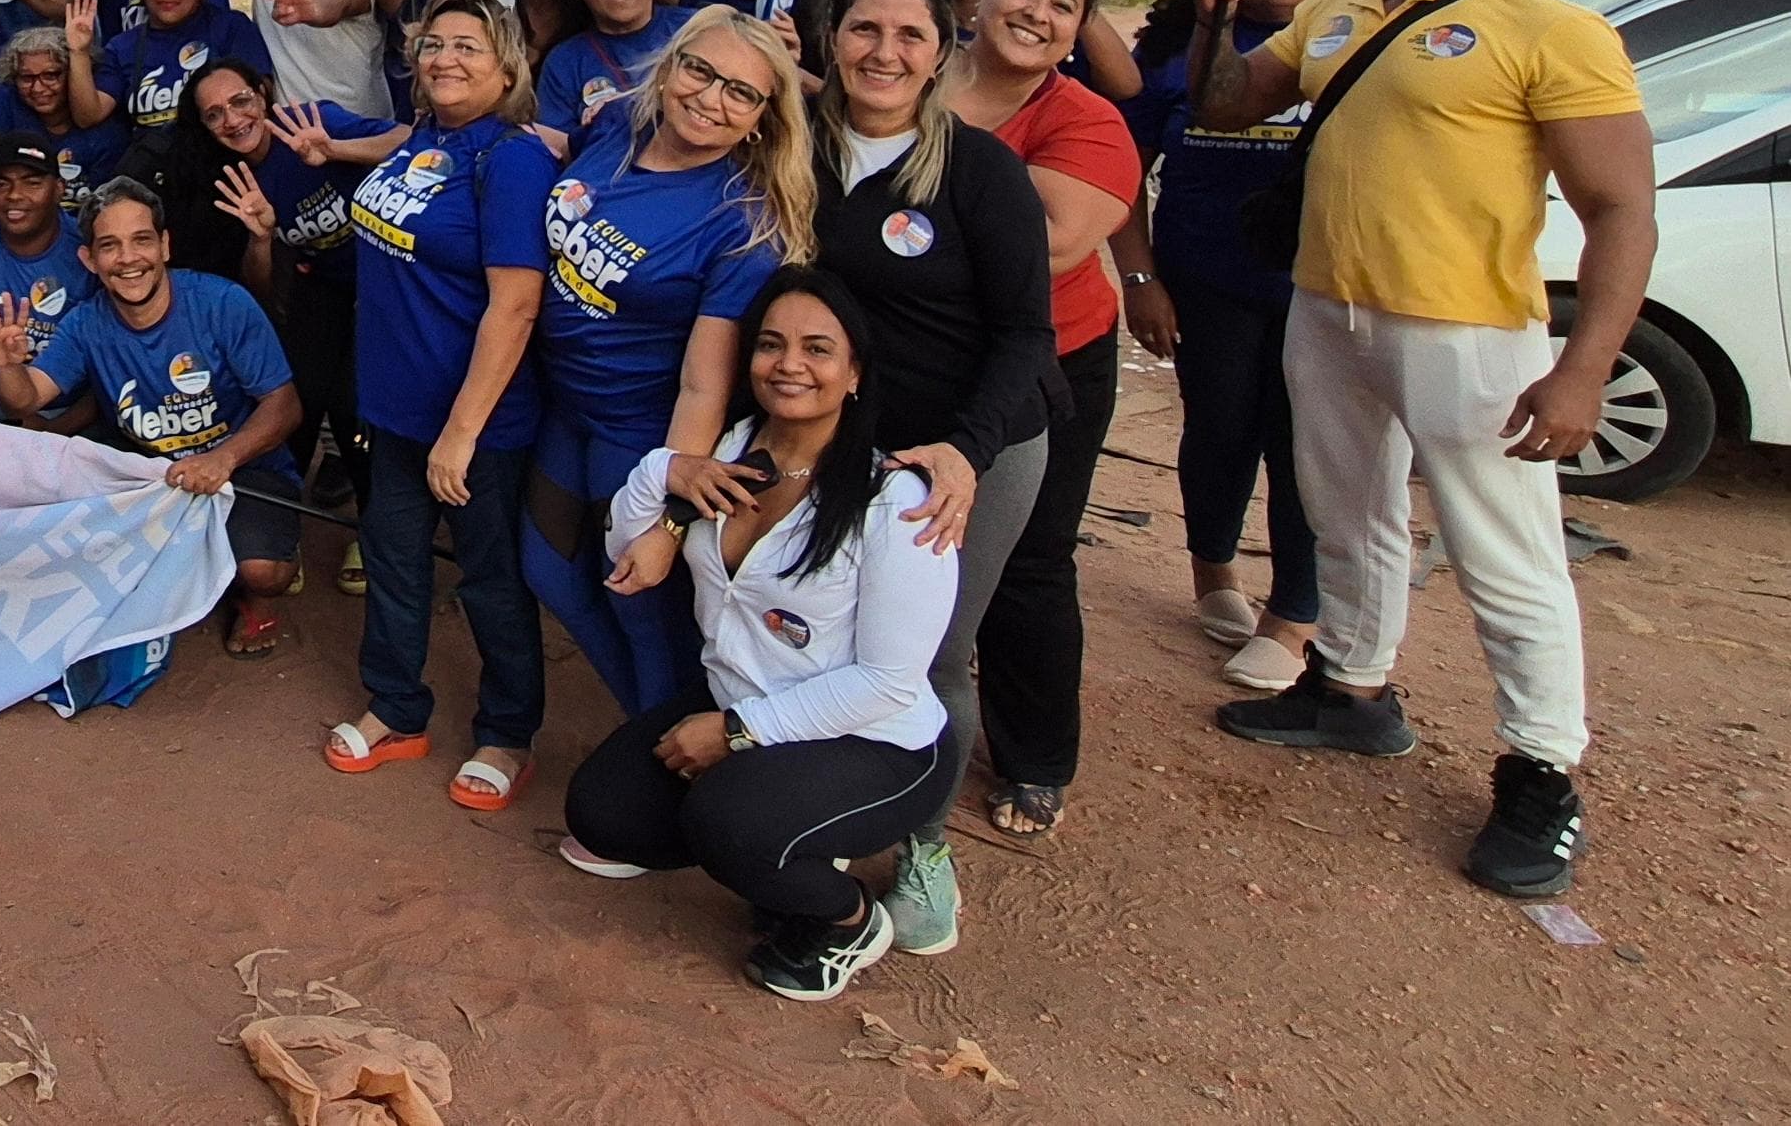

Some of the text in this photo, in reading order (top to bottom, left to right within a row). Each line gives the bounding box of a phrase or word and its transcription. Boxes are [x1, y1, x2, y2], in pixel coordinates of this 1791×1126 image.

[1183, 136, 1251, 151] Construindo
[352, 167, 429, 227] leber
[275, 194, 348, 246] leber
[593, 218, 647, 261] EQUIPE
[585, 225, 635, 269] Vereador
